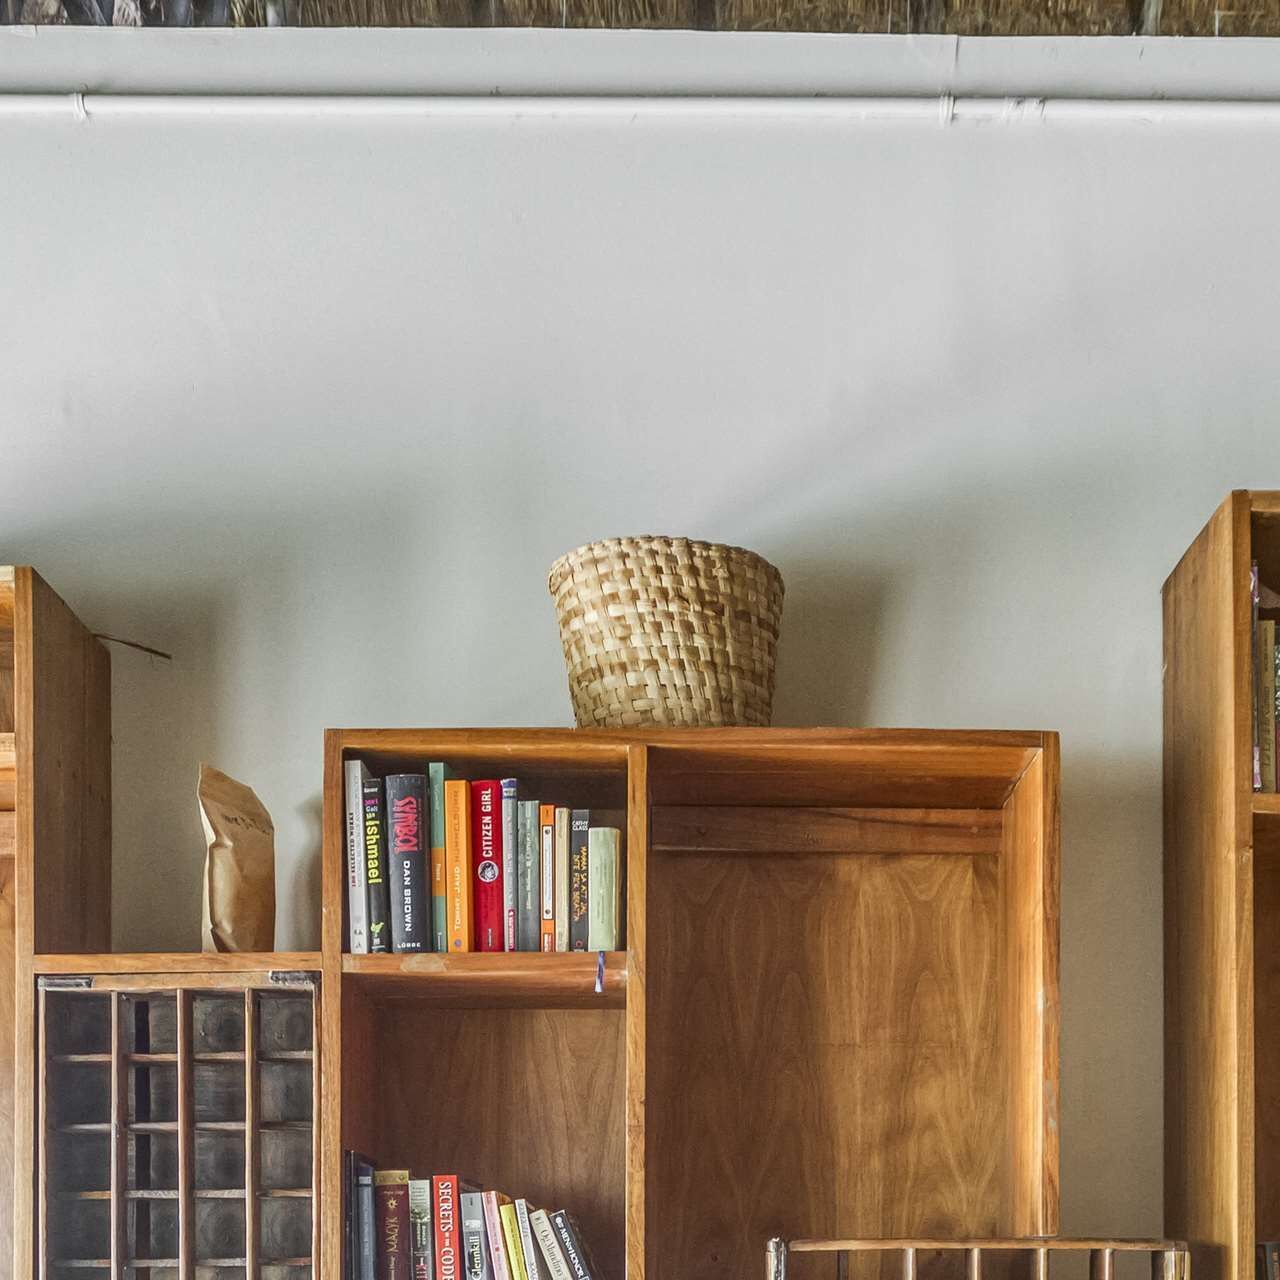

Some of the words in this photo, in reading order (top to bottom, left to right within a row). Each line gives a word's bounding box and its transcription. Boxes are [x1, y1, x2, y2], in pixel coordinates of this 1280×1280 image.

[481, 788, 491, 811] GIRL
[366, 818, 382, 884] Ishmael
[482, 816, 491, 856] CITIZEN
[403, 860, 411, 886] DAN
[404, 888, 412, 932] BROWN
[438, 1182, 453, 1231] SECRETS
[385, 1216, 399, 1252] MAGYK
[558, 1227, 571, 1245] MEN
[567, 1249, 585, 1278] HONOR
[469, 1236, 481, 1280] Glennkill
